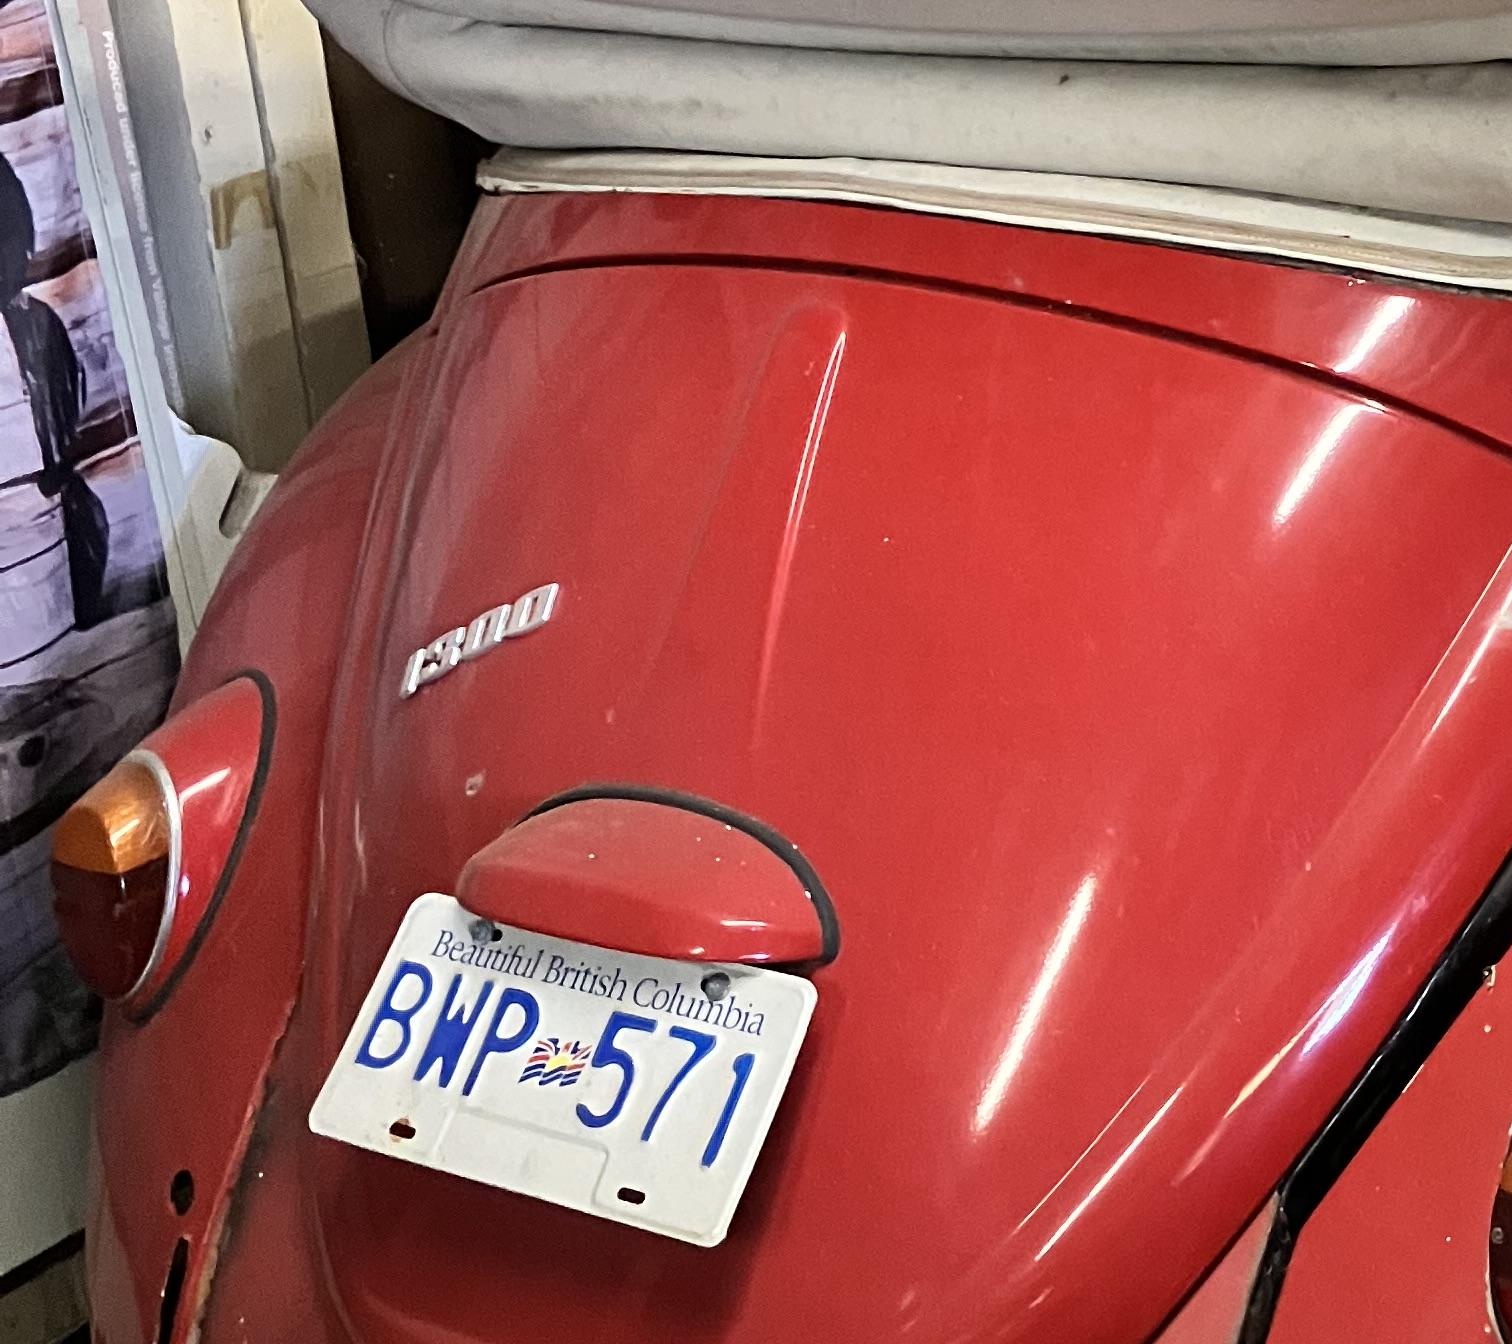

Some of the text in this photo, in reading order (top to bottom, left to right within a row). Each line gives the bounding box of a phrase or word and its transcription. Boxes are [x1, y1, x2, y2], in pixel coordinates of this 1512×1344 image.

[431, 929, 766, 1036] Beautiful British Columbia
[354, 960, 756, 1168] BWP 571
